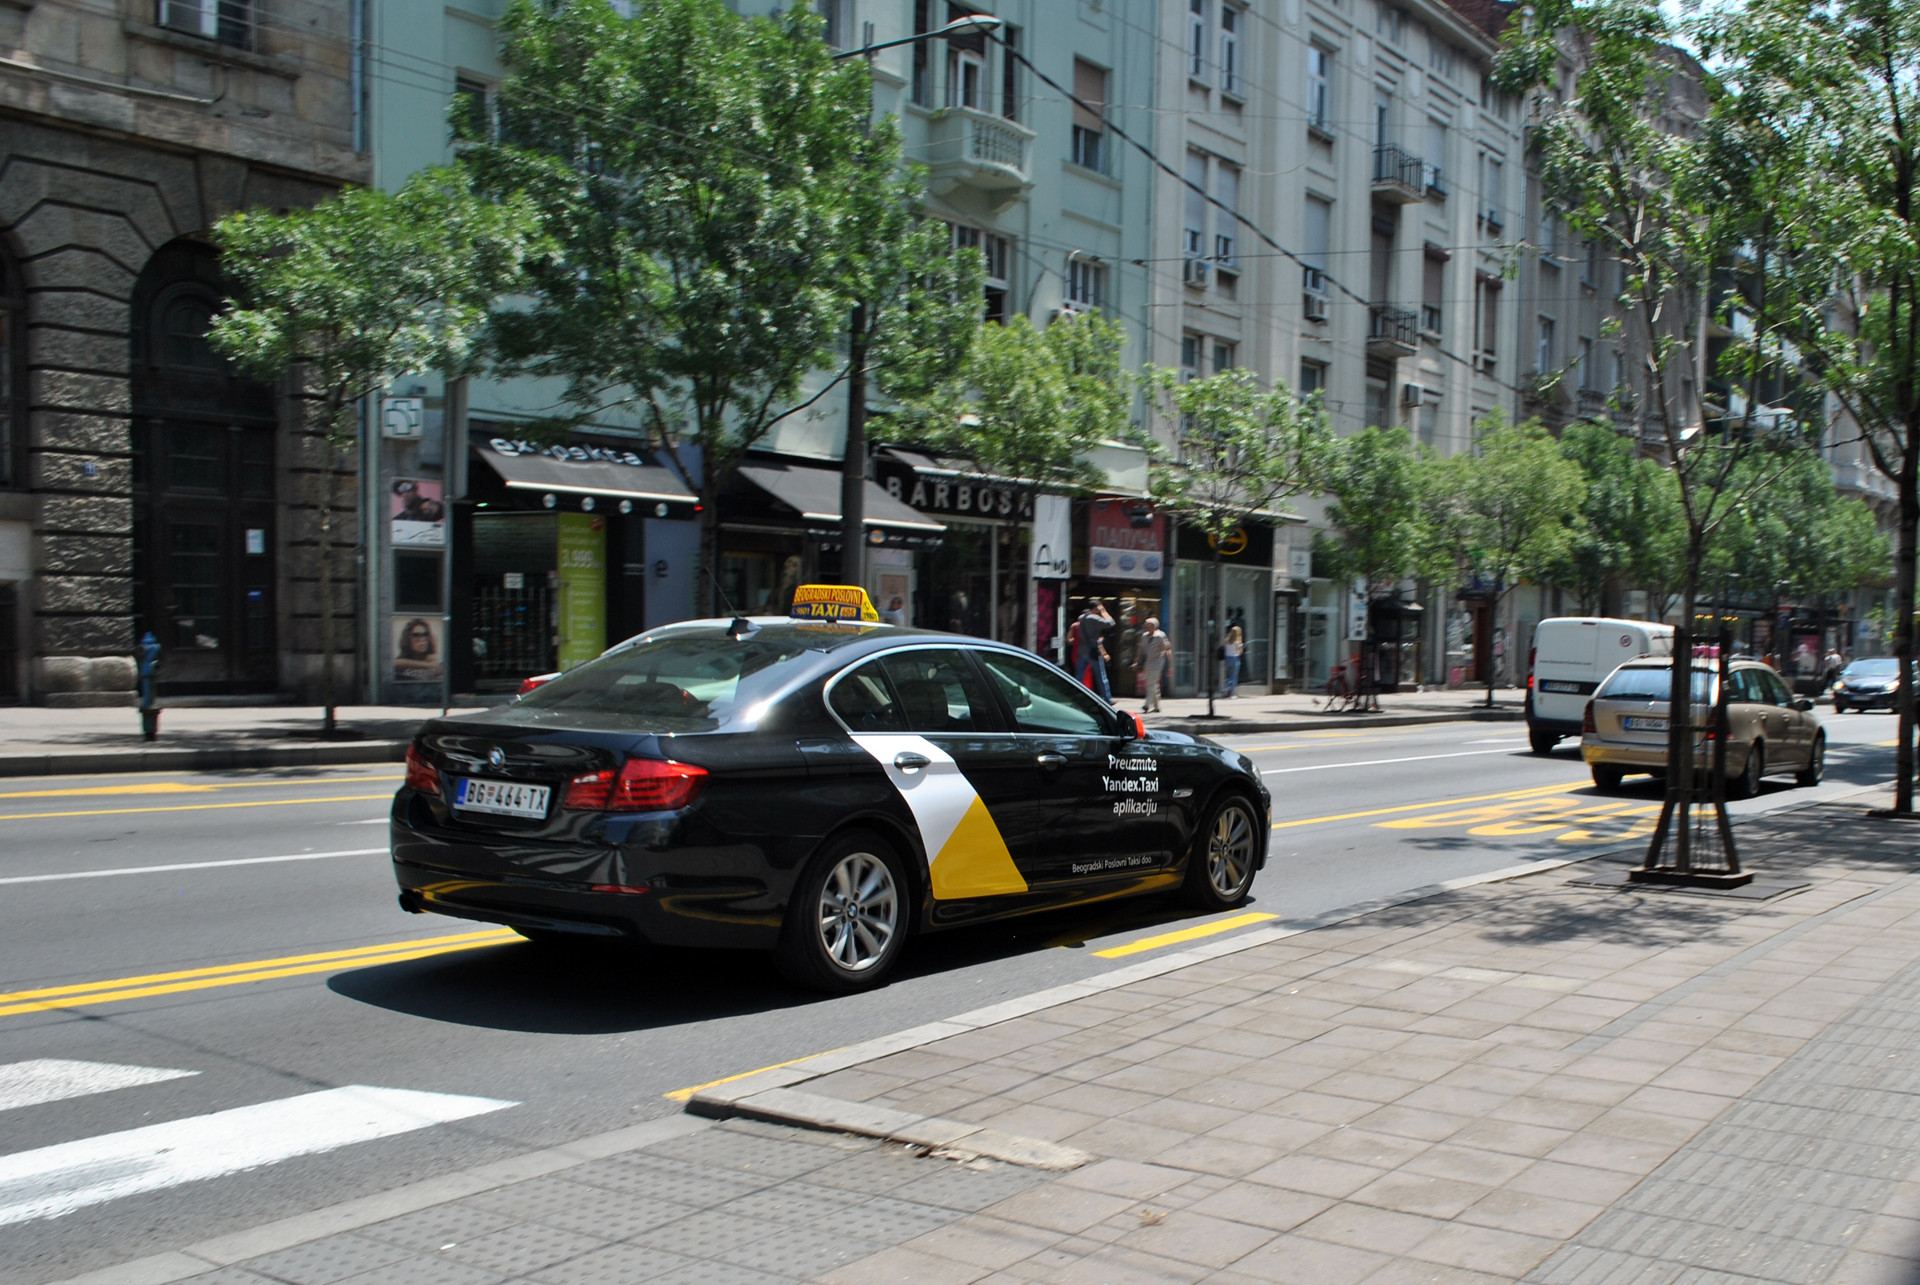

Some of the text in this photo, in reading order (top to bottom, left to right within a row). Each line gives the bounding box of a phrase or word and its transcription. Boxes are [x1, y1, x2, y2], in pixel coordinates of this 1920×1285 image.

[489, 437, 643, 466] expekta
[886, 476, 1033, 518] BARBOSA
[794, 588, 861, 605] BEOGRADSKI POSLOVNI
[811, 603, 840, 617] TAXI
[1108, 754, 1157, 771] Preuzmite
[1102, 775, 1159, 792] Yandex.Taxi
[467, 782, 485, 804] BG
[1113, 799, 1157, 816] aplikaciju
[1072, 855, 1152, 874] Beogradski Poslovni Taksi doo
